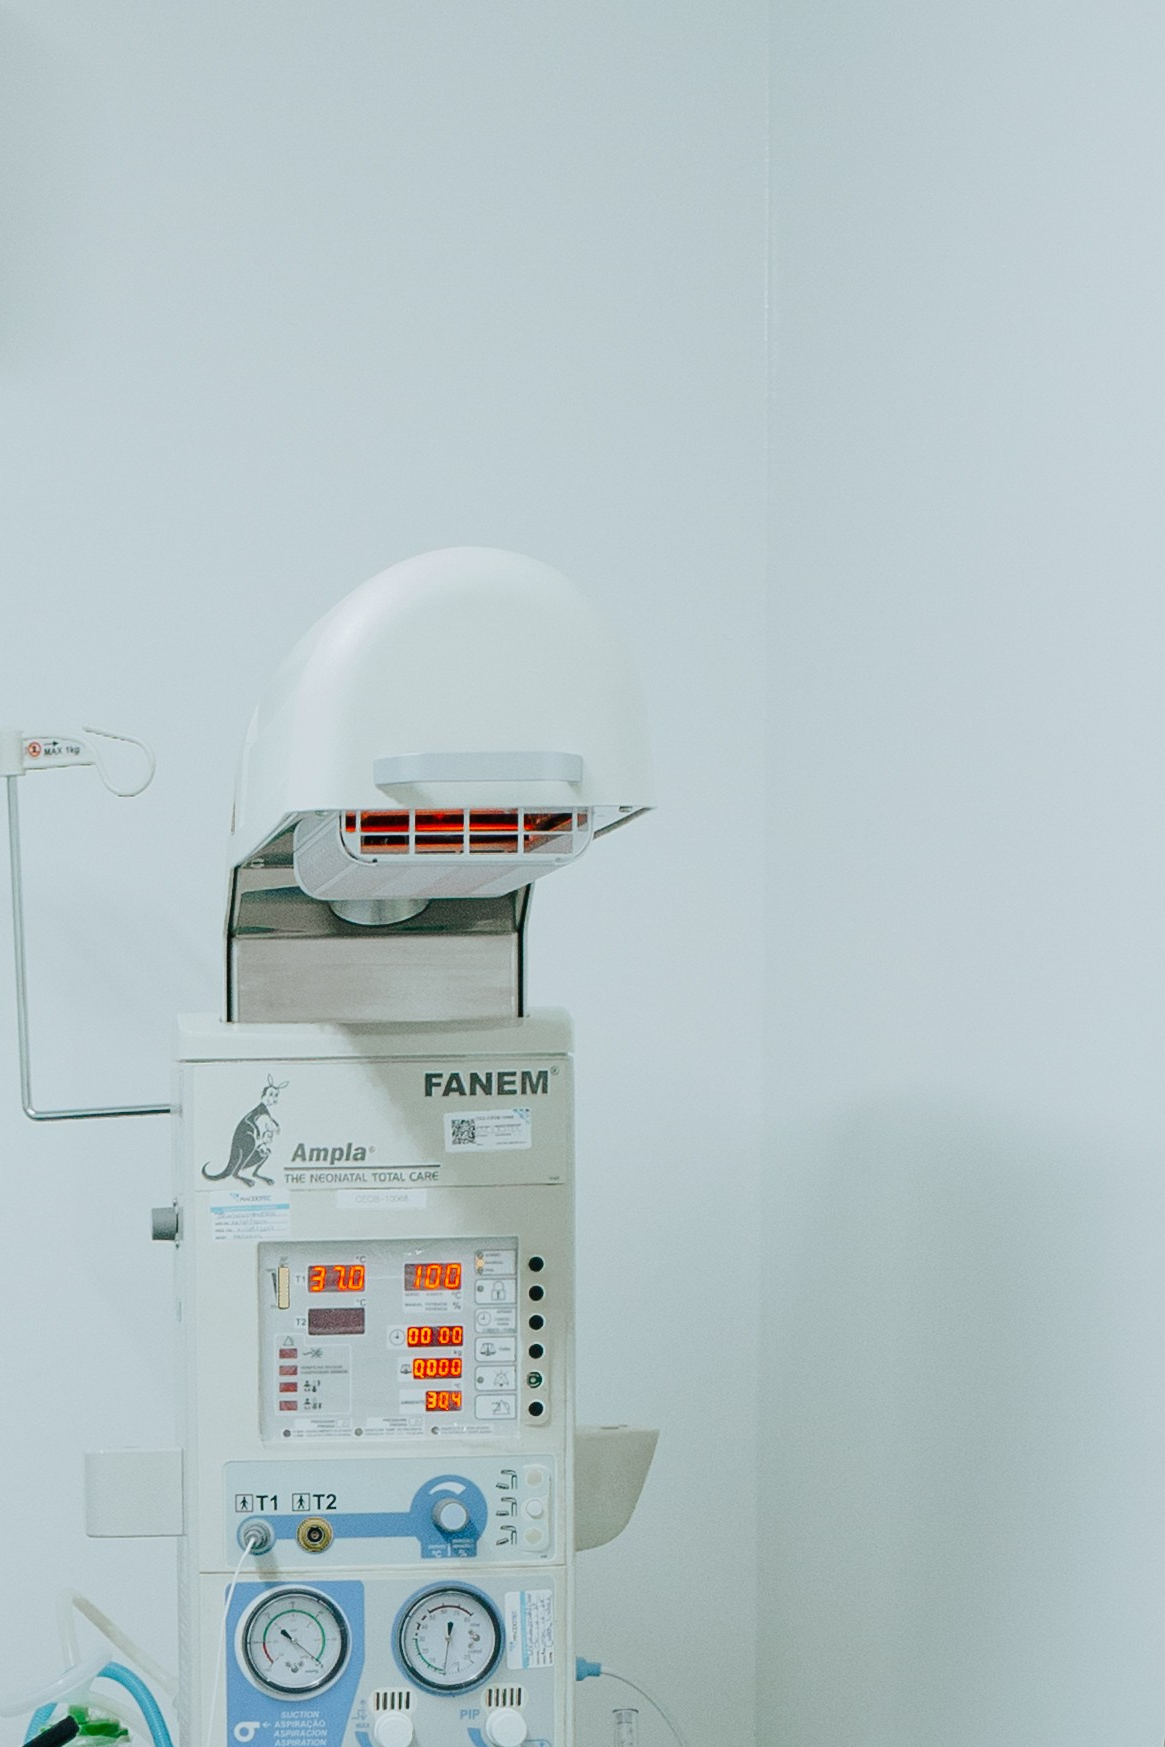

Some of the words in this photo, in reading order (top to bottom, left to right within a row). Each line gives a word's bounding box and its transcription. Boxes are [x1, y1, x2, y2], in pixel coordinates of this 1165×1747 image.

[424, 1070, 549, 1097] FANEM
[291, 1142, 367, 1165] Ampla
[285, 1173, 306, 1183] THE
[310, 1172, 367, 1183] NEONATAL
[372, 1171, 405, 1182] TOTAL
[409, 1170, 439, 1181] CARE
[414, 1263, 461, 1289] 100
[296, 1318, 306, 1326] T2
[256, 1494, 277, 1511] T1
[313, 1493, 337, 1510] T2
[281, 1711, 320, 1719] SUCTION
[459, 1709, 480, 1720] PIP
